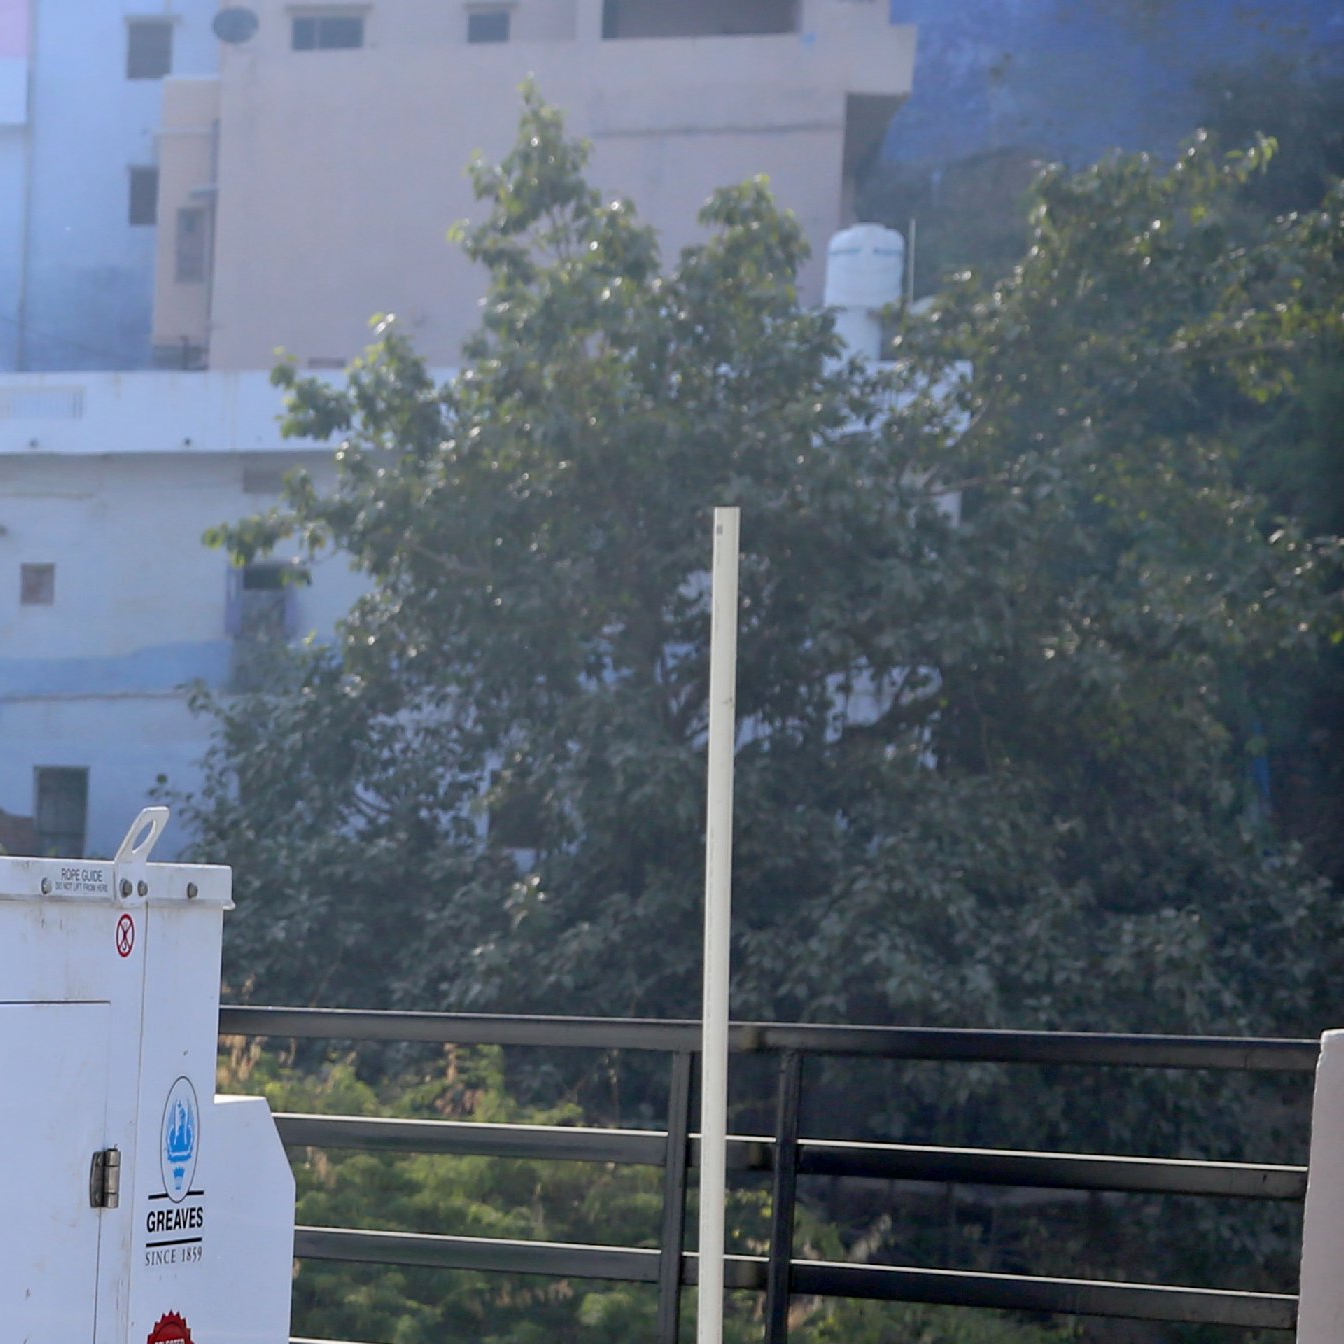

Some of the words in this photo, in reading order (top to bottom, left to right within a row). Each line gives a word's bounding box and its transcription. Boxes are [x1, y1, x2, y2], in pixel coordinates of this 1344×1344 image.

[61, 868, 80, 881] ROPE
[82, 869, 103, 882] GUIDE
[146, 1207, 204, 1233] GREAVES
[145, 1249, 177, 1267] SINCE
[181, 1246, 203, 1263] 1859
